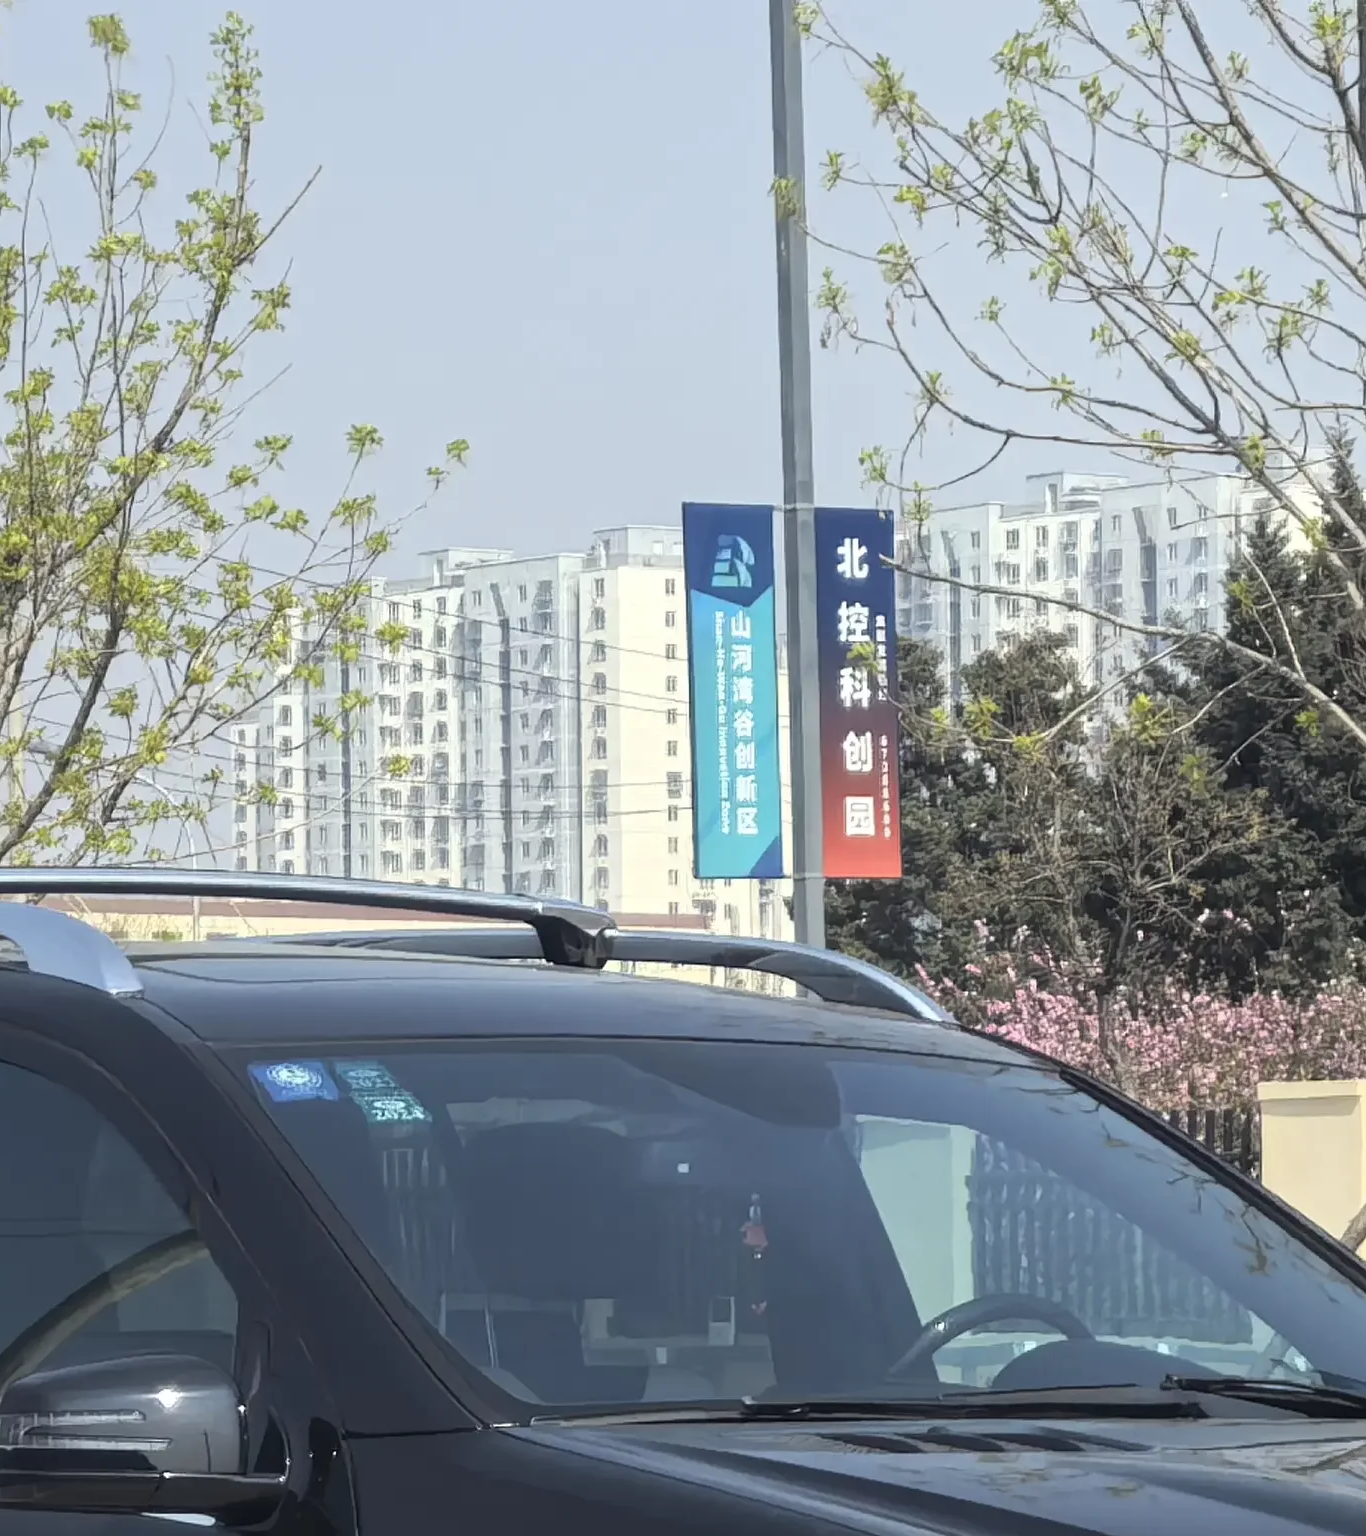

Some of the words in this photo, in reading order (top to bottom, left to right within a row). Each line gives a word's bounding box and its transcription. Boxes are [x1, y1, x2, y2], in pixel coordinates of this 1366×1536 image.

[731, 610, 758, 835] 山河湾谷创新区
[836, 537, 876, 837] 北控科创园
